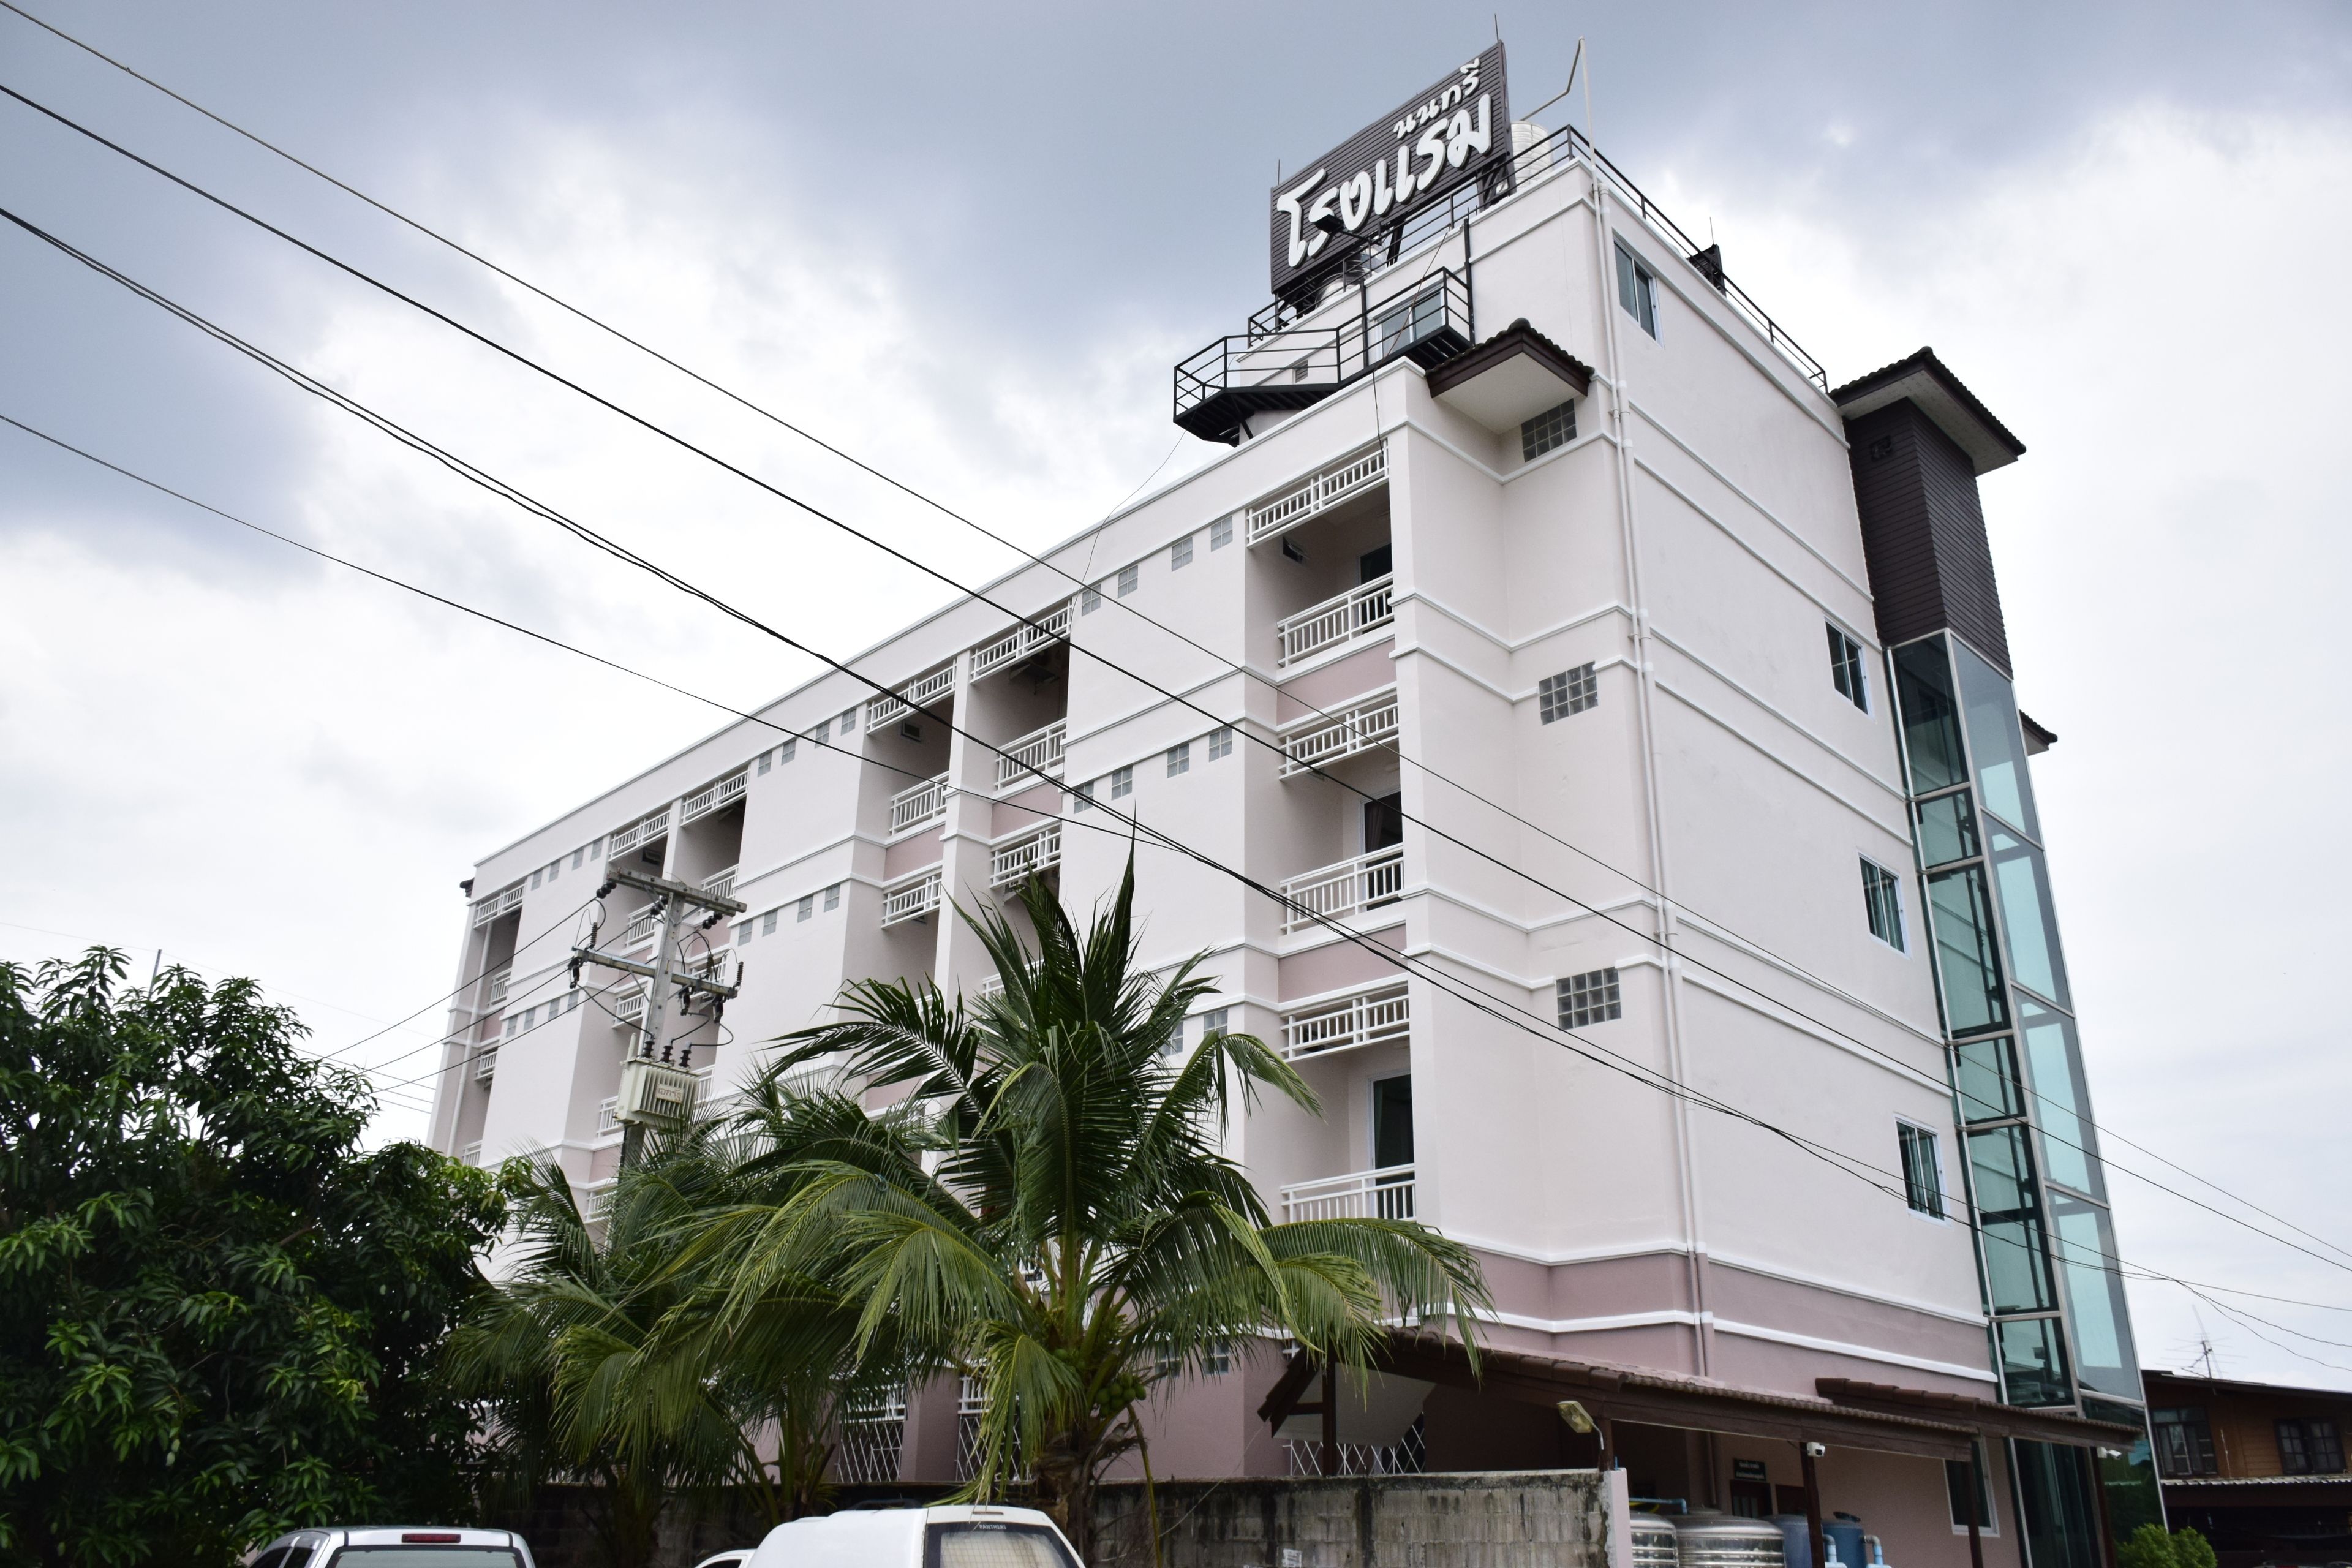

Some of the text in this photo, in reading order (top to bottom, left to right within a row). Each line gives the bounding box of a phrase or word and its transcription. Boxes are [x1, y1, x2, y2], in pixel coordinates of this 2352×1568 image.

[1393, 58, 1480, 139] นนทรี
[1277, 94, 1491, 267] โรงแรม
